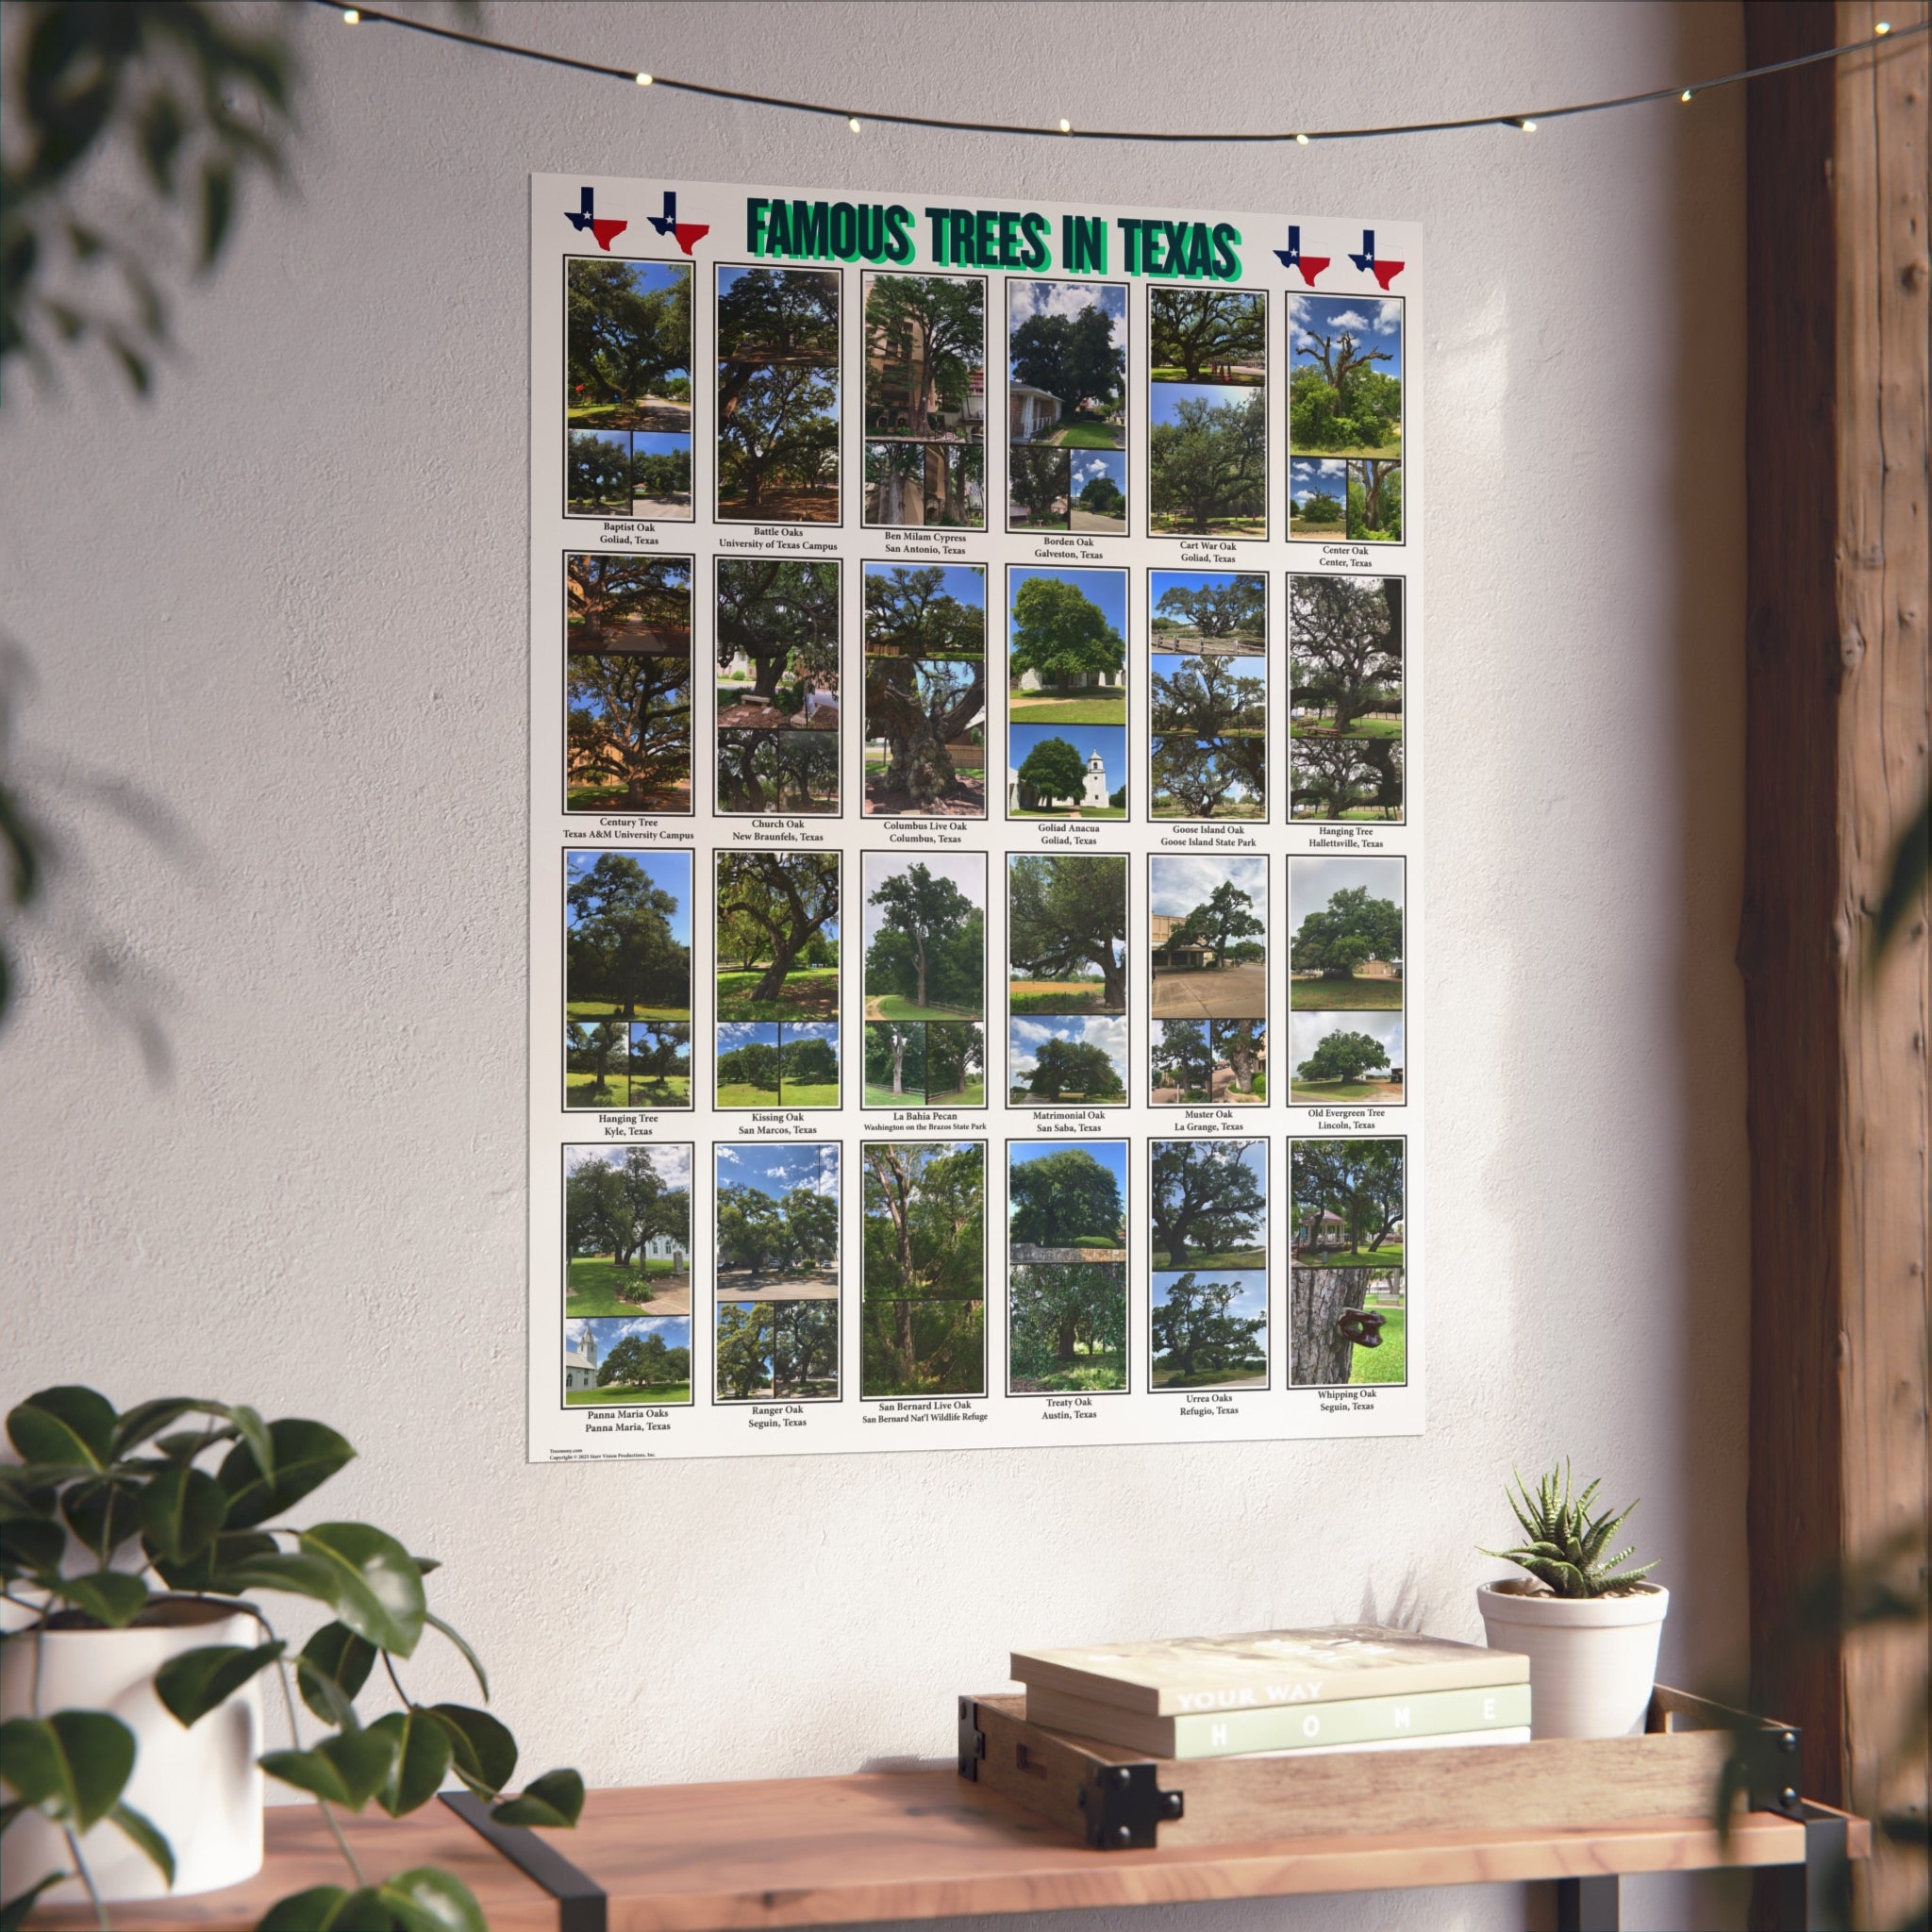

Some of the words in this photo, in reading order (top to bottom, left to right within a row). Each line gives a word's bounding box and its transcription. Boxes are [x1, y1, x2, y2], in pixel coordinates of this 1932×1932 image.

[746, 197, 916, 266] FAMOUS
[924, 208, 1052, 273] TREES
[1062, 214, 1108, 275] IN
[1117, 217, 1241, 281] TEXAS
[603, 522, 635, 534] Baptist
[636, 523, 656, 532] Oak
[753, 526, 779, 536] Battle
[780, 527, 804, 537] Oaks
[598, 534, 633, 545] Goliad,
[633, 535, 659, 545] Texas
[884, 530, 902, 541] Ben
[902, 531, 931, 541] Milam
[932, 532, 967, 544] Cypress
[1043, 536, 1074, 546] Borden
[1075, 537, 1094, 547] Oak
[718, 538, 764, 551] University
[764, 539, 775, 549] of
[774, 540, 801, 550] Texas
[801, 541, 838, 553] Campus
[884, 543, 901, 553] San
[902, 544, 941, 555] Antonio,
[941, 545, 966, 555] Texas
[1179, 540, 1199, 550] Cart
[1200, 541, 1218, 550] War
[1218, 541, 1237, 551] Oak
[1322, 544, 1351, 555] Center
[1350, 545, 1369, 556] Oak
[1033, 548, 1078, 559] Galveston,
[1079, 549, 1104, 559] Texas
[1179, 552, 1211, 563] Goliad,
[1211, 553, 1236, 563] Texas
[1318, 557, 1349, 568] Center,
[1349, 558, 1373, 568] Texas
[598, 817, 637, 829] Century
[637, 817, 658, 827] Tree
[751, 818, 785, 828] Church
[785, 819, 805, 828] Oak
[882, 820, 928, 830] Columbus
[929, 821, 948, 830] Live
[948, 821, 968, 831] Oak
[1037, 823, 1067, 832] Goliad
[1067, 824, 1100, 833] Anacua
[561, 829, 587, 839] Texas
[588, 829, 612, 839] A&M
[613, 829, 658, 841] University
[658, 830, 694, 841] Campus
[1172, 824, 1199, 834] Goose
[1199, 824, 1225, 834] Island
[1226, 824, 1245, 835] Oak
[1318, 825, 1355, 838] Hanging
[1355, 826, 1374, 836] Tree
[731, 831, 753, 841] New
[753, 831, 798, 842] Braunfels,
[798, 832, 824, 841] Texas
[889, 833, 937, 844] Columbus,
[937, 834, 962, 843] Texas
[1040, 835, 1073, 845] Goliad,
[1073, 835, 1097, 845] Texas
[1159, 837, 1187, 846] Goose
[1188, 837, 1214, 846] Island
[1214, 837, 1236, 847] State
[1237, 837, 1257, 847] Park
[1307, 838, 1360, 849] Hallettsville,
[1360, 839, 1384, 848] Texas
[598, 1113, 638, 1125] Hanging
[638, 1113, 658, 1123] Tree
[751, 1112, 785, 1124] Kissing
[785, 1111, 805, 1122] Oak
[892, 1111, 905, 1121] La
[905, 1110, 931, 1121] Bahia
[931, 1111, 958, 1121] Pecan
[1032, 1110, 1086, 1120] Matrimonial
[1087, 1109, 1106, 1120] Oak
[1184, 1109, 1214, 1119] Muster
[1214, 1108, 1233, 1119] Oak
[1307, 1108, 1324, 1118] Old
[1324, 1108, 1366, 1120] Evergreen
[1366, 1108, 1386, 1117] Tree
[738, 1125, 755, 1135] San
[756, 1124, 791, 1135] Marcos,
[791, 1124, 817, 1134] Texas
[862, 1123, 905, 1133] Washington
[915, 1123, 927, 1131] the
[970, 1122, 987, 1130] Park
[1036, 1123, 1053, 1133] San
[1053, 1123, 1077, 1133] Saba,
[1077, 1123, 1102, 1132] Texas
[1174, 1122, 1185, 1131] La
[1185, 1122, 1220, 1133] Grange,
[1220, 1122, 1244, 1131] Texas
[1317, 1120, 1352, 1130] Lincoln,
[1352, 1120, 1375, 1129] Texas
[604, 1125, 626, 1139] Kyle,
[627, 1125, 653, 1136] Texas
[1185, 1393, 1210, 1404] Urrea
[1210, 1392, 1233, 1403] Oaks
[1317, 1390, 1358, 1401] Whipping
[1358, 1389, 1377, 1398] Oak
[878, 1402, 895, 1411] San
[896, 1400, 932, 1411] Bernard
[933, 1400, 952, 1410] Live
[952, 1399, 972, 1409] Oak
[1045, 1398, 1074, 1408] Treaty
[1074, 1396, 1092, 1407] Oak
[1319, 1402, 1351, 1413] Seguin,
[1351, 1401, 1374, 1410] Texas
[587, 1410, 616, 1420] Panna
[616, 1408, 644, 1419] Maria
[644, 1407, 669, 1418] Oaks
[751, 1406, 784, 1417] Ranger
[784, 1404, 804, 1414] Oak
[1041, 1410, 1073, 1420] Austin,
[1073, 1409, 1097, 1419] Texas
[1179, 1406, 1215, 1418] Refugio,
[1215, 1406, 1240, 1415] Texas
[861, 1415, 876, 1424] San
[877, 1413, 909, 1424] Bernard
[929, 1411, 961, 1422] Wildlife
[961, 1411, 989, 1423] Refuge
[584, 1423, 613, 1433] Panna
[614, 1422, 644, 1432] Maria,
[645, 1421, 671, 1431] Texas
[747, 1418, 781, 1430] Seguin,
[782, 1417, 808, 1427] Texas
[1177, 1688, 1257, 1711] YOUR
[1265, 1682, 1323, 1702] WAY
